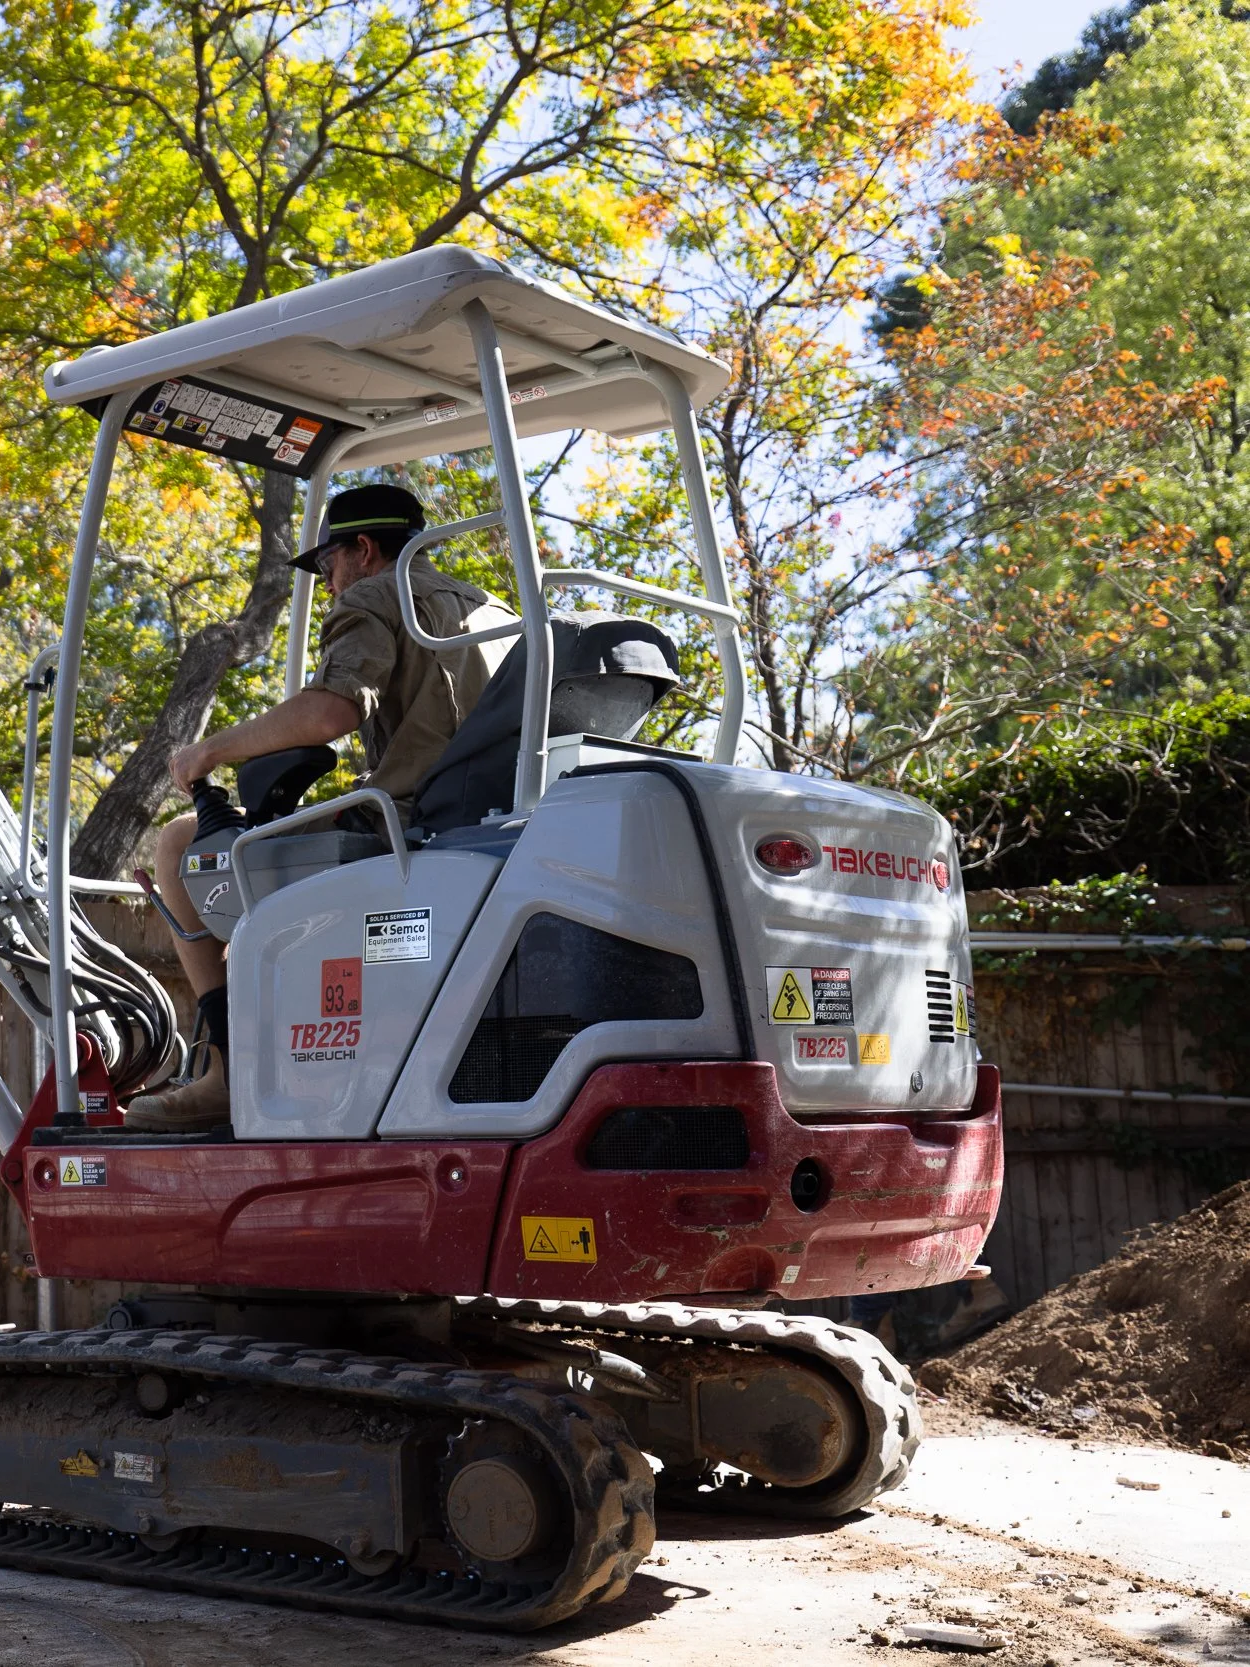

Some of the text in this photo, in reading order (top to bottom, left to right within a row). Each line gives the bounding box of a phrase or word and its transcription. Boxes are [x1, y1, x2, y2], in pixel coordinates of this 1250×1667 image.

[390, 912, 417, 921] SERVICED
[389, 924, 425, 936] Semco
[368, 934, 426, 947] Equipment Sales
[820, 970, 850, 979] DANGER
[831, 982, 847, 990] CLEAR
[814, 989, 822, 997] OF
[822, 989, 839, 997] SWING
[325, 984, 359, 1013] 93 dB
[817, 1003, 849, 1011] REVERSING
[815, 1012, 852, 1020] FREQUENTLY
[290, 1020, 362, 1050] TB225
[797, 1037, 847, 1059] TB225
